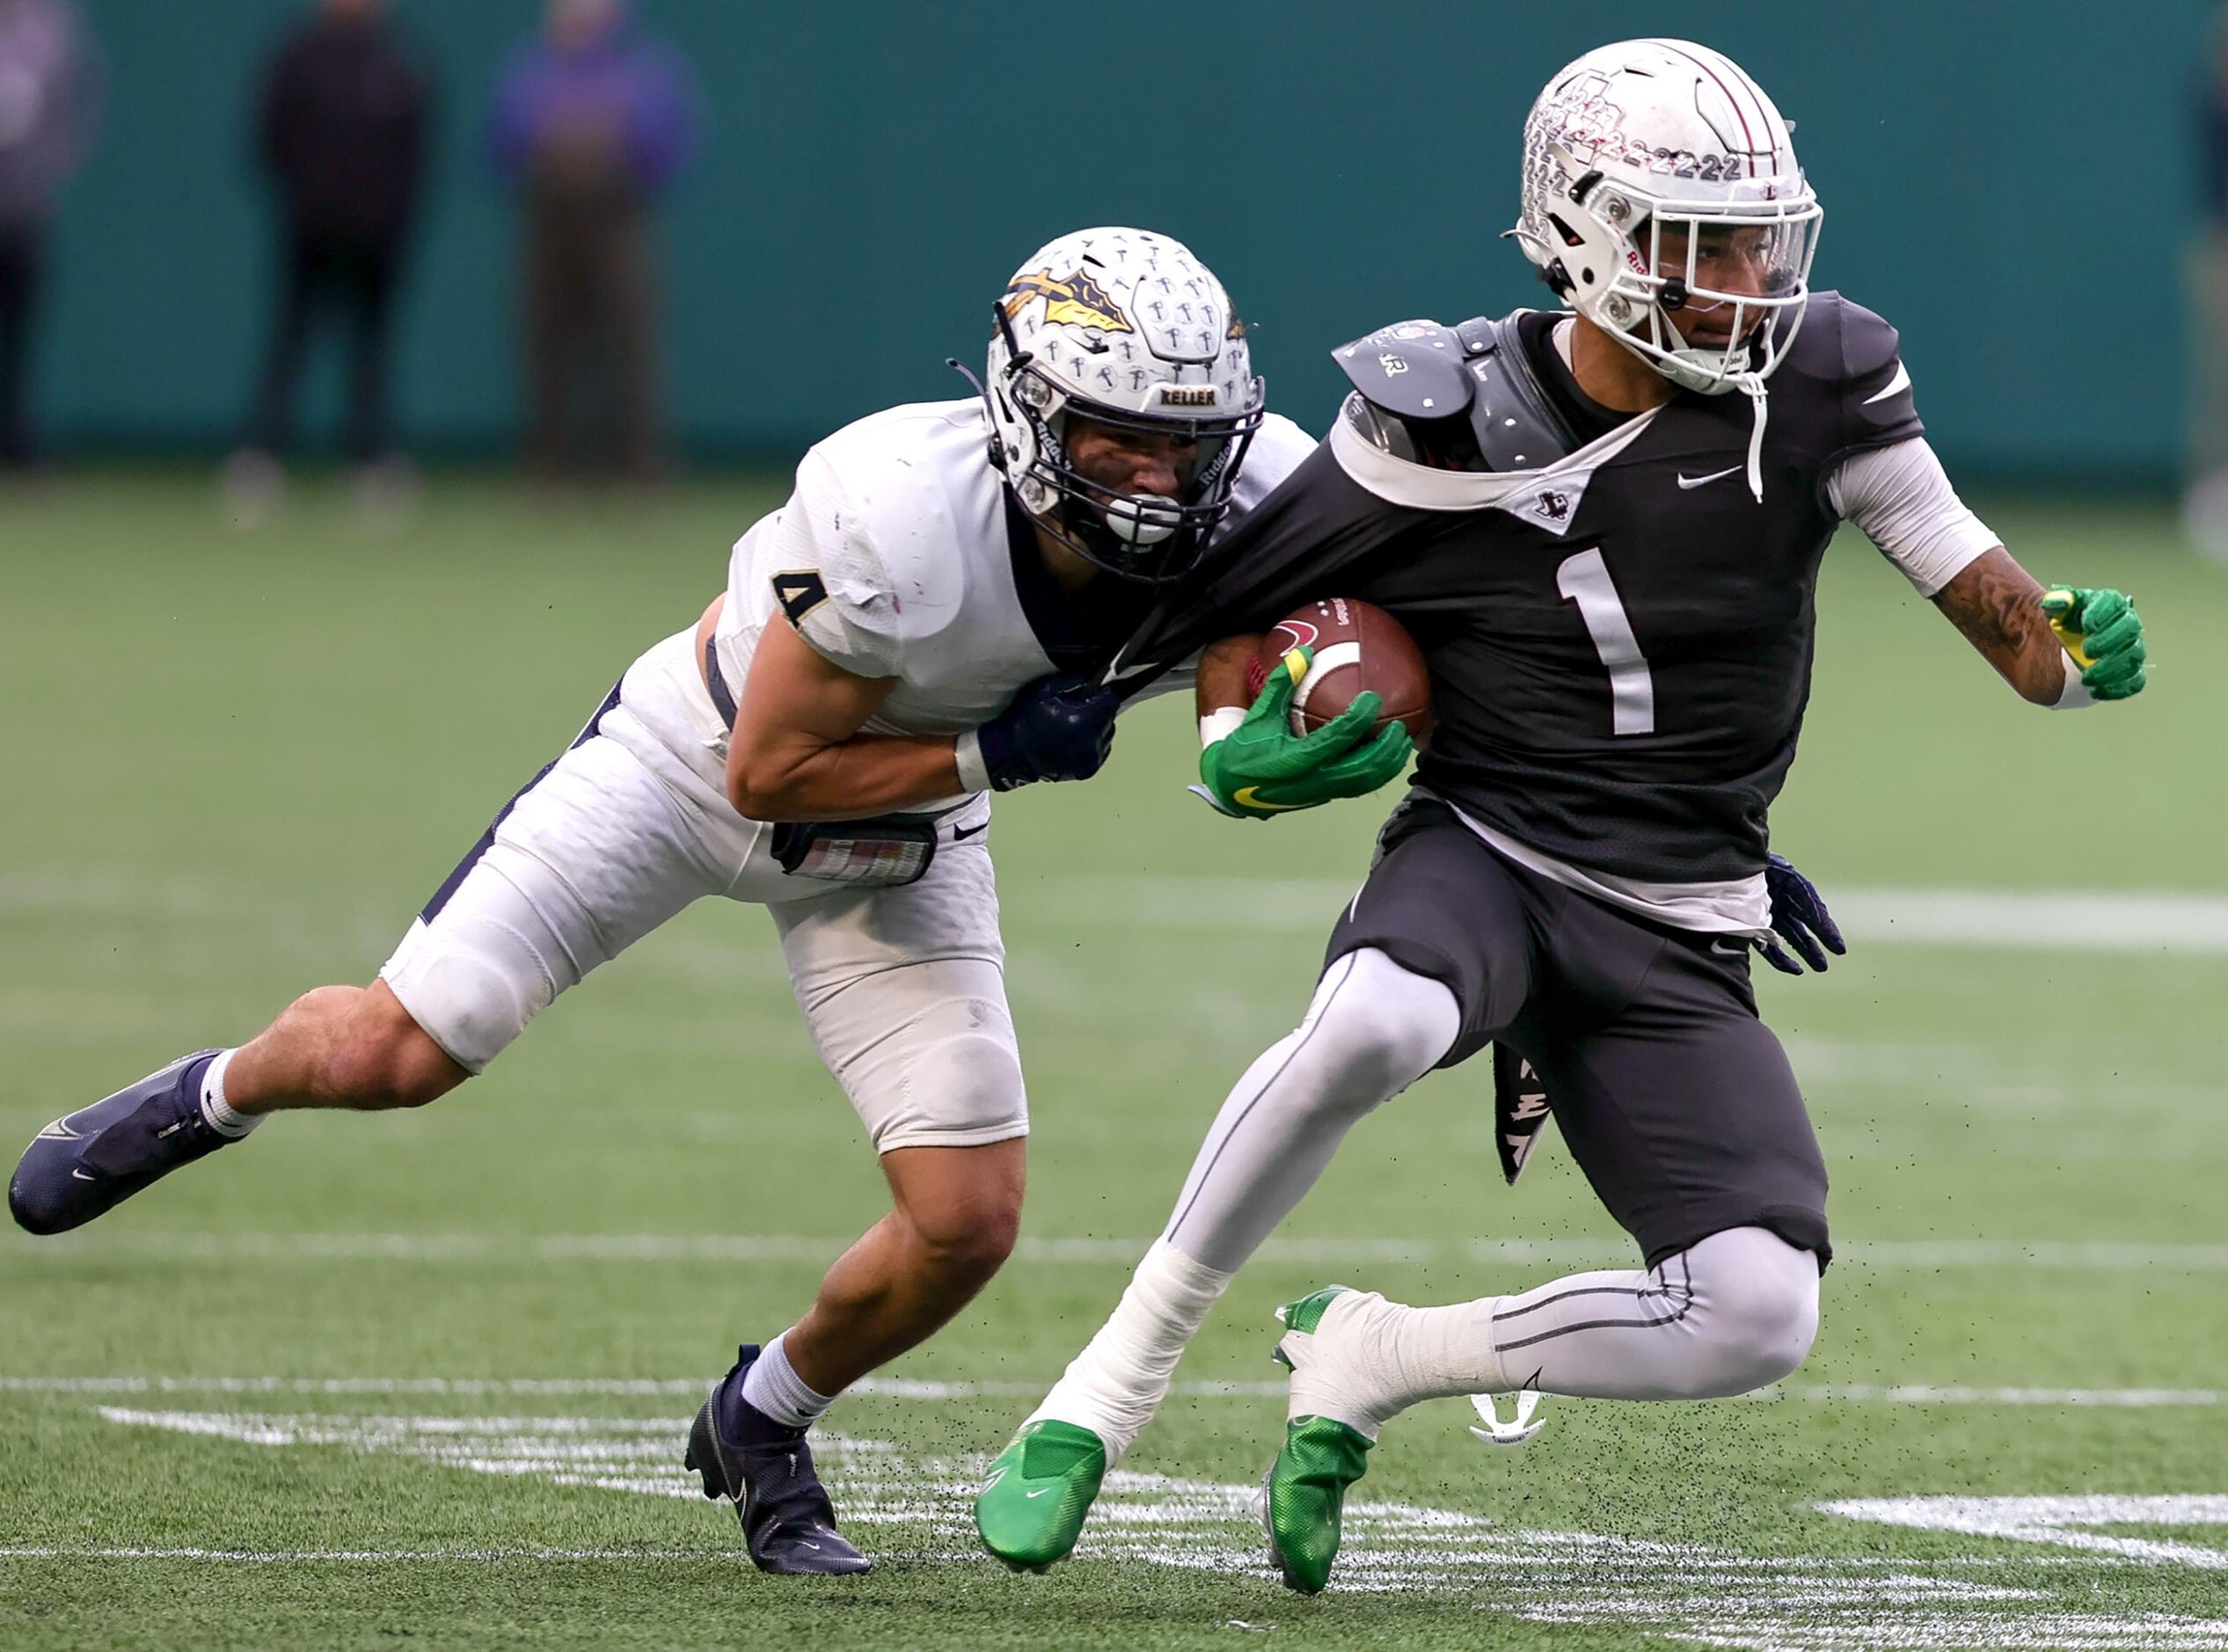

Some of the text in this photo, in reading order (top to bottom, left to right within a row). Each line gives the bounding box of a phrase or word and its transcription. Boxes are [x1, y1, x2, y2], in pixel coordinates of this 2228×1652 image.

[1160, 389, 1216, 406] KELLER
[769, 568, 830, 631] 4
[1557, 546, 1654, 735] 1
